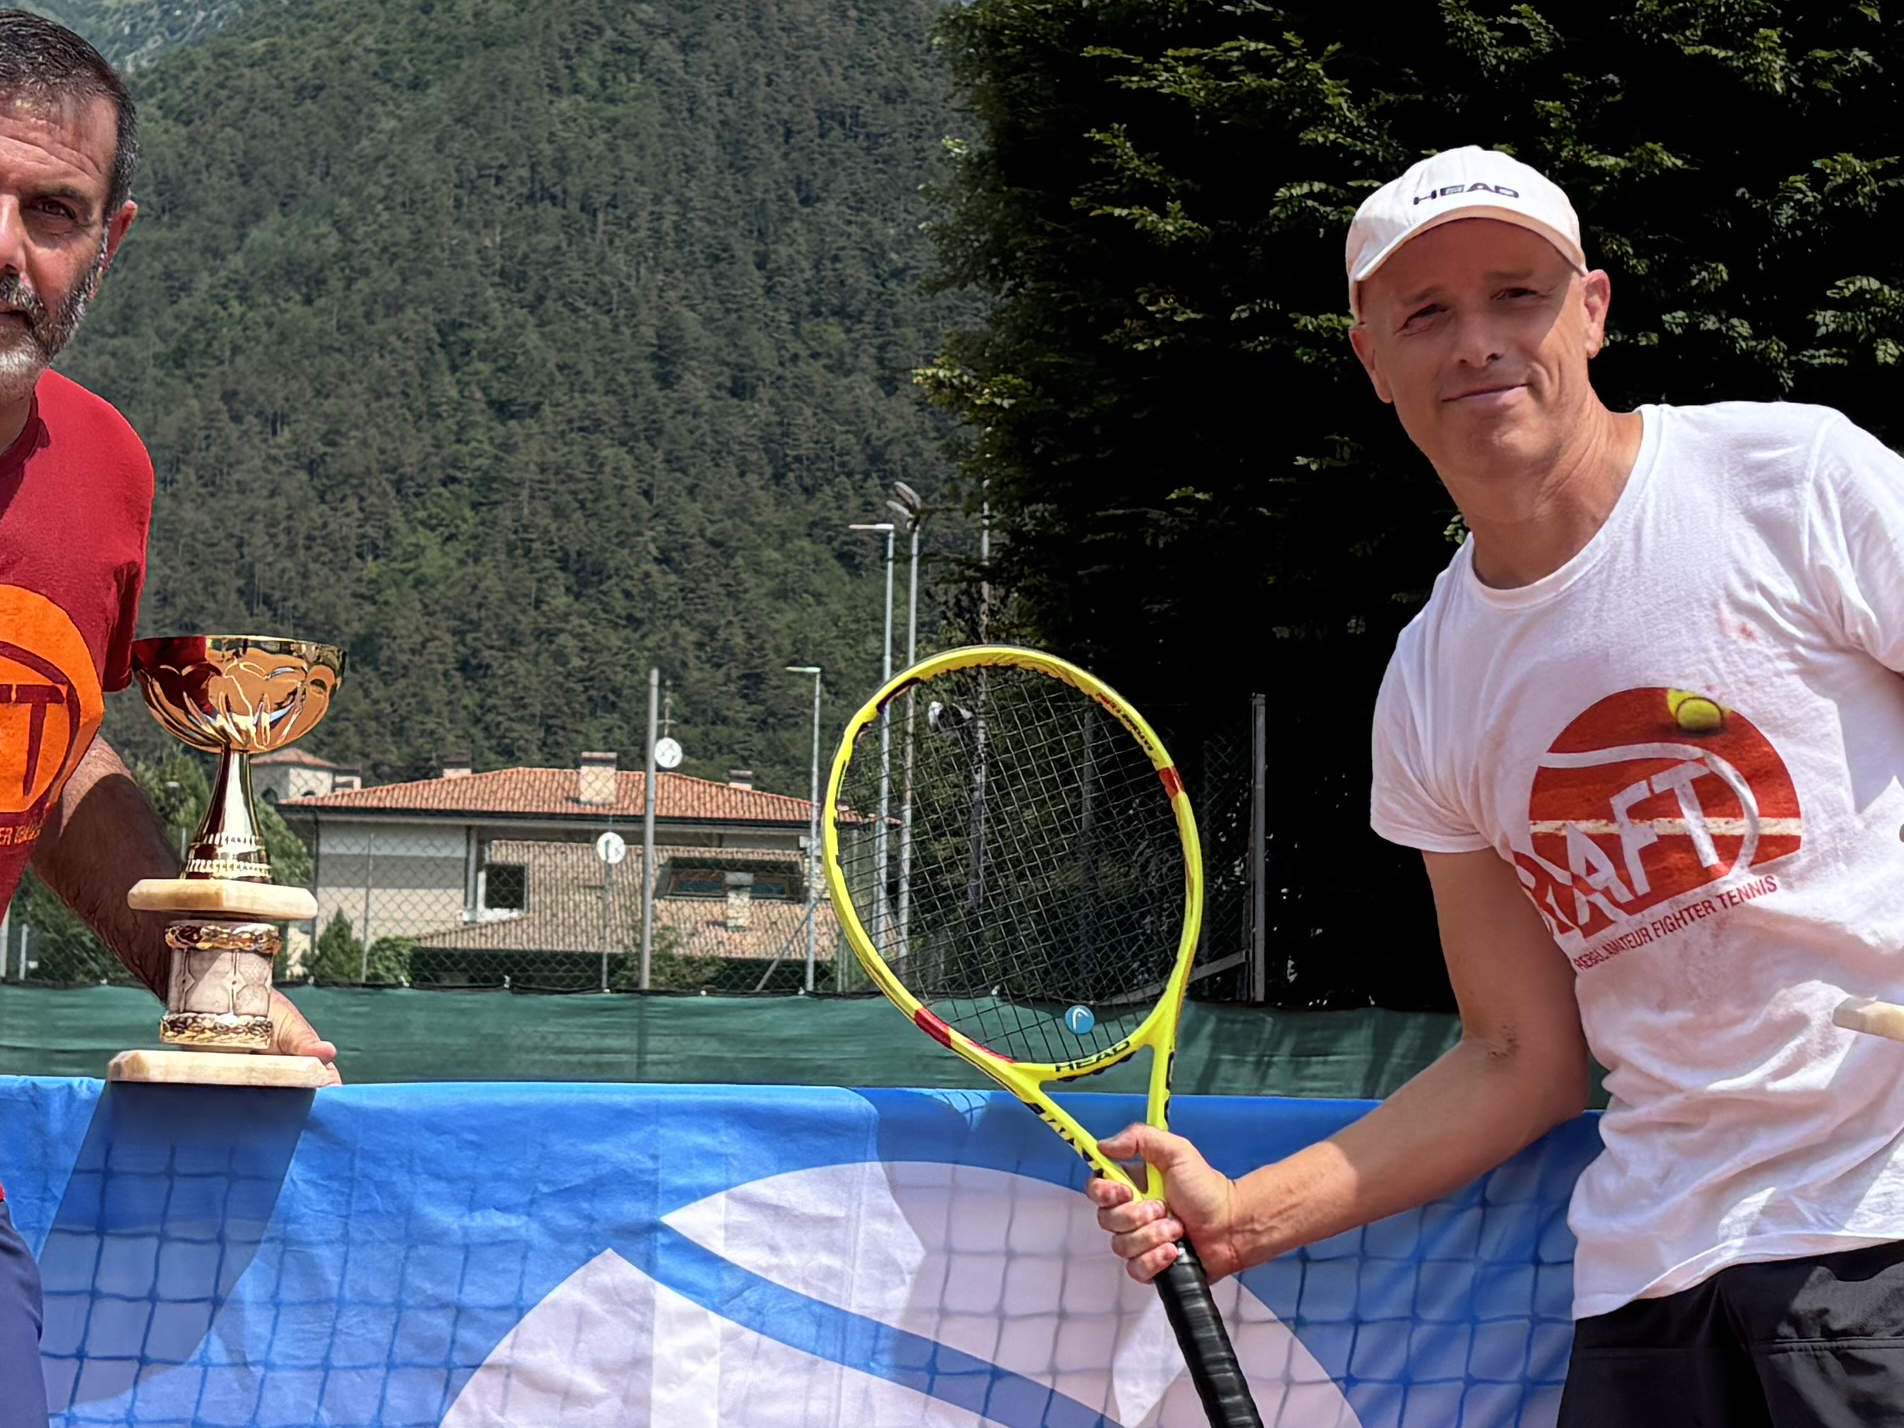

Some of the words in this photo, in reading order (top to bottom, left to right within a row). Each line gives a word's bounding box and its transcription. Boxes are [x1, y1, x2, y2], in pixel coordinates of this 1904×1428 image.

[1413, 182, 1519, 206] HEAD
[1605, 927, 1653, 958] AMATEUR
[1652, 898, 1717, 939] FIGHTER
[1716, 875, 1778, 910] TENNIS
[1055, 1040, 1130, 1072] HEAD
